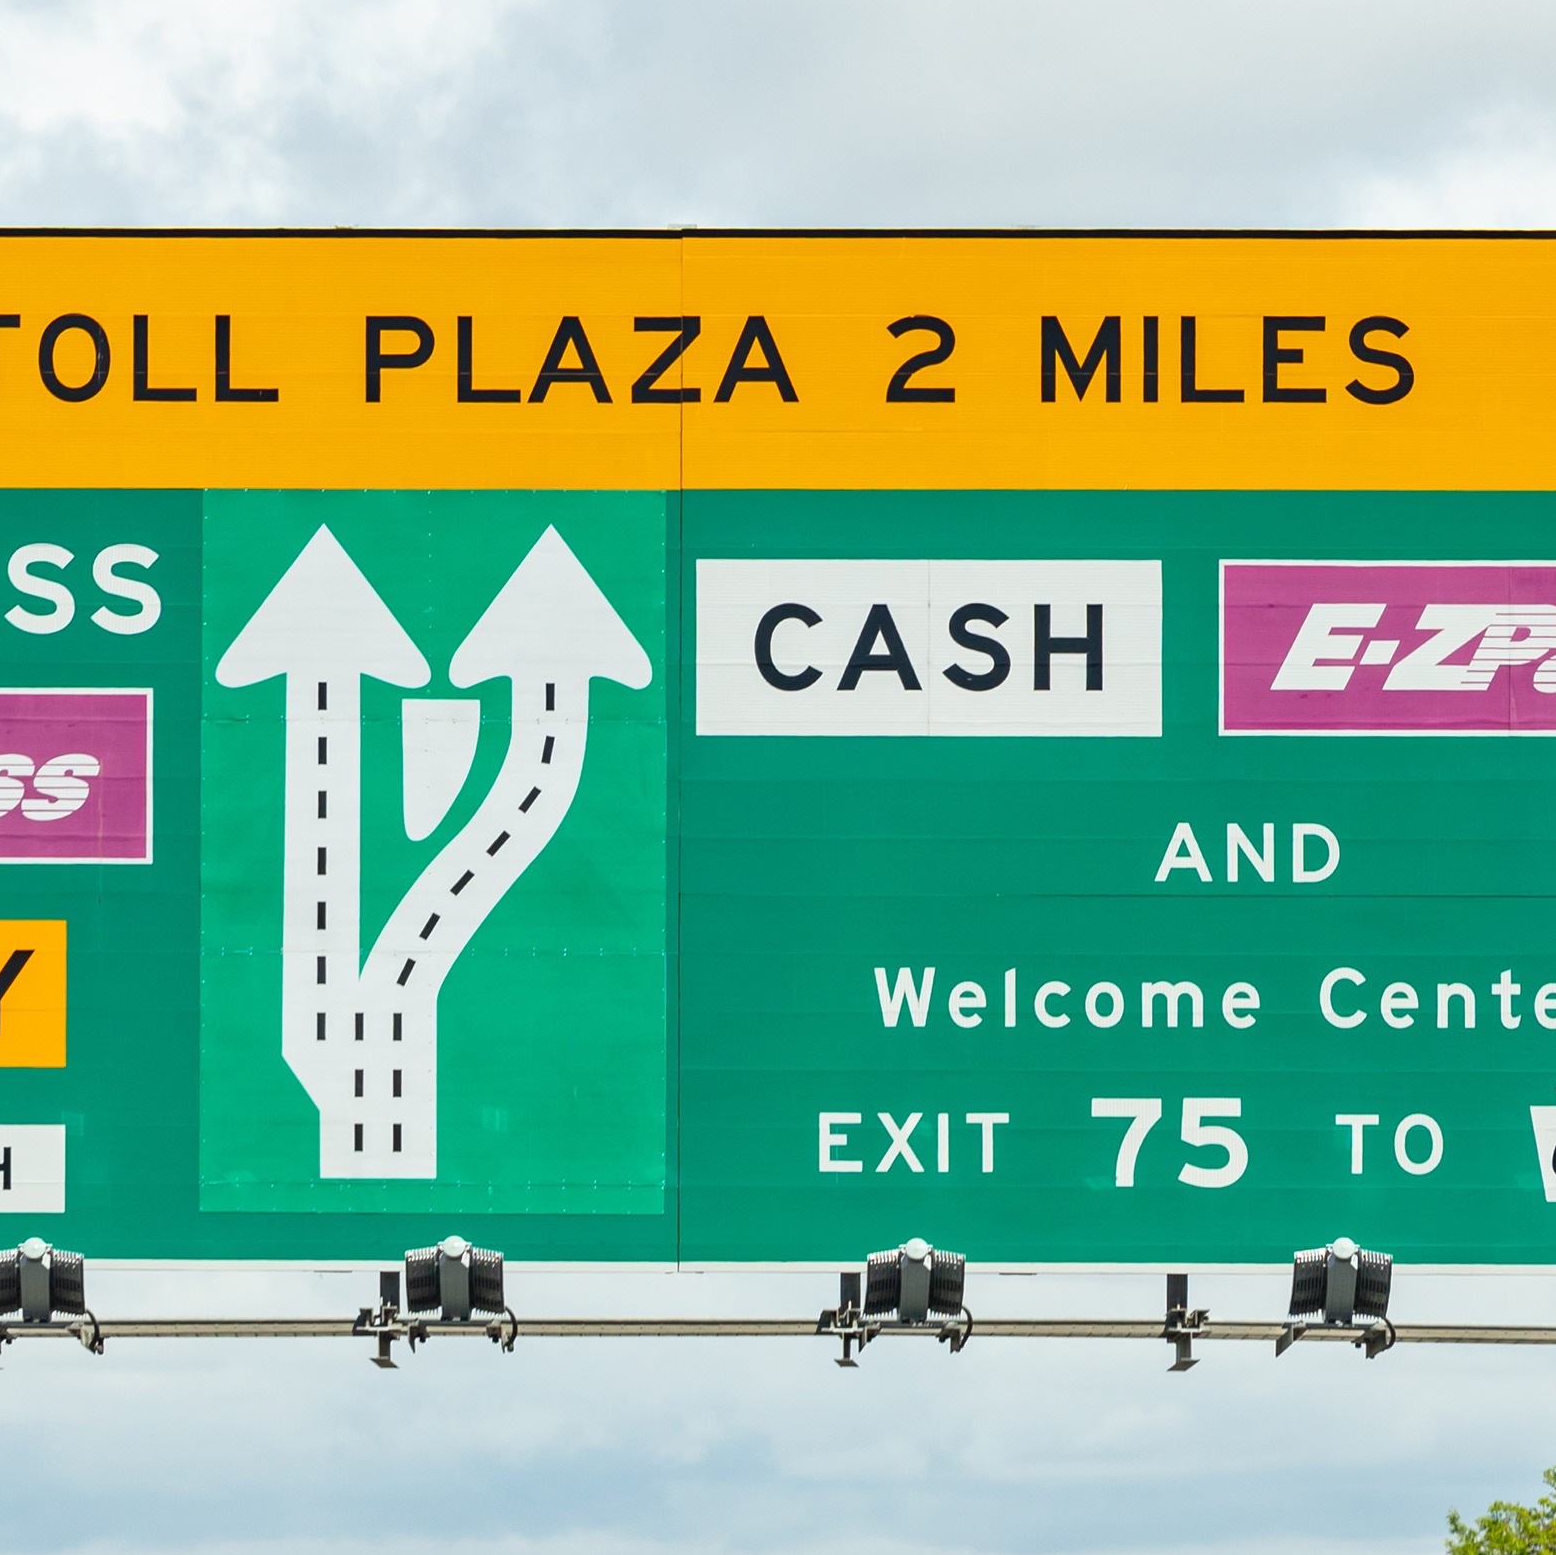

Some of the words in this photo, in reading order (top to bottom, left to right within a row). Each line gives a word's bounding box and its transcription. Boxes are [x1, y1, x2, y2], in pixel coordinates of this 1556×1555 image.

[365, 315, 799, 404] PLAZA
[886, 315, 956, 403] 2
[1041, 315, 1415, 405] MILES
[754, 602, 1103, 692] CASH
[1154, 822, 1340, 883] AND
[874, 967, 1260, 1029] Welcome
[819, 1112, 1010, 1173] EXIT
[1091, 1097, 1248, 1188] 75
[1335, 1113, 1444, 1175] TO
